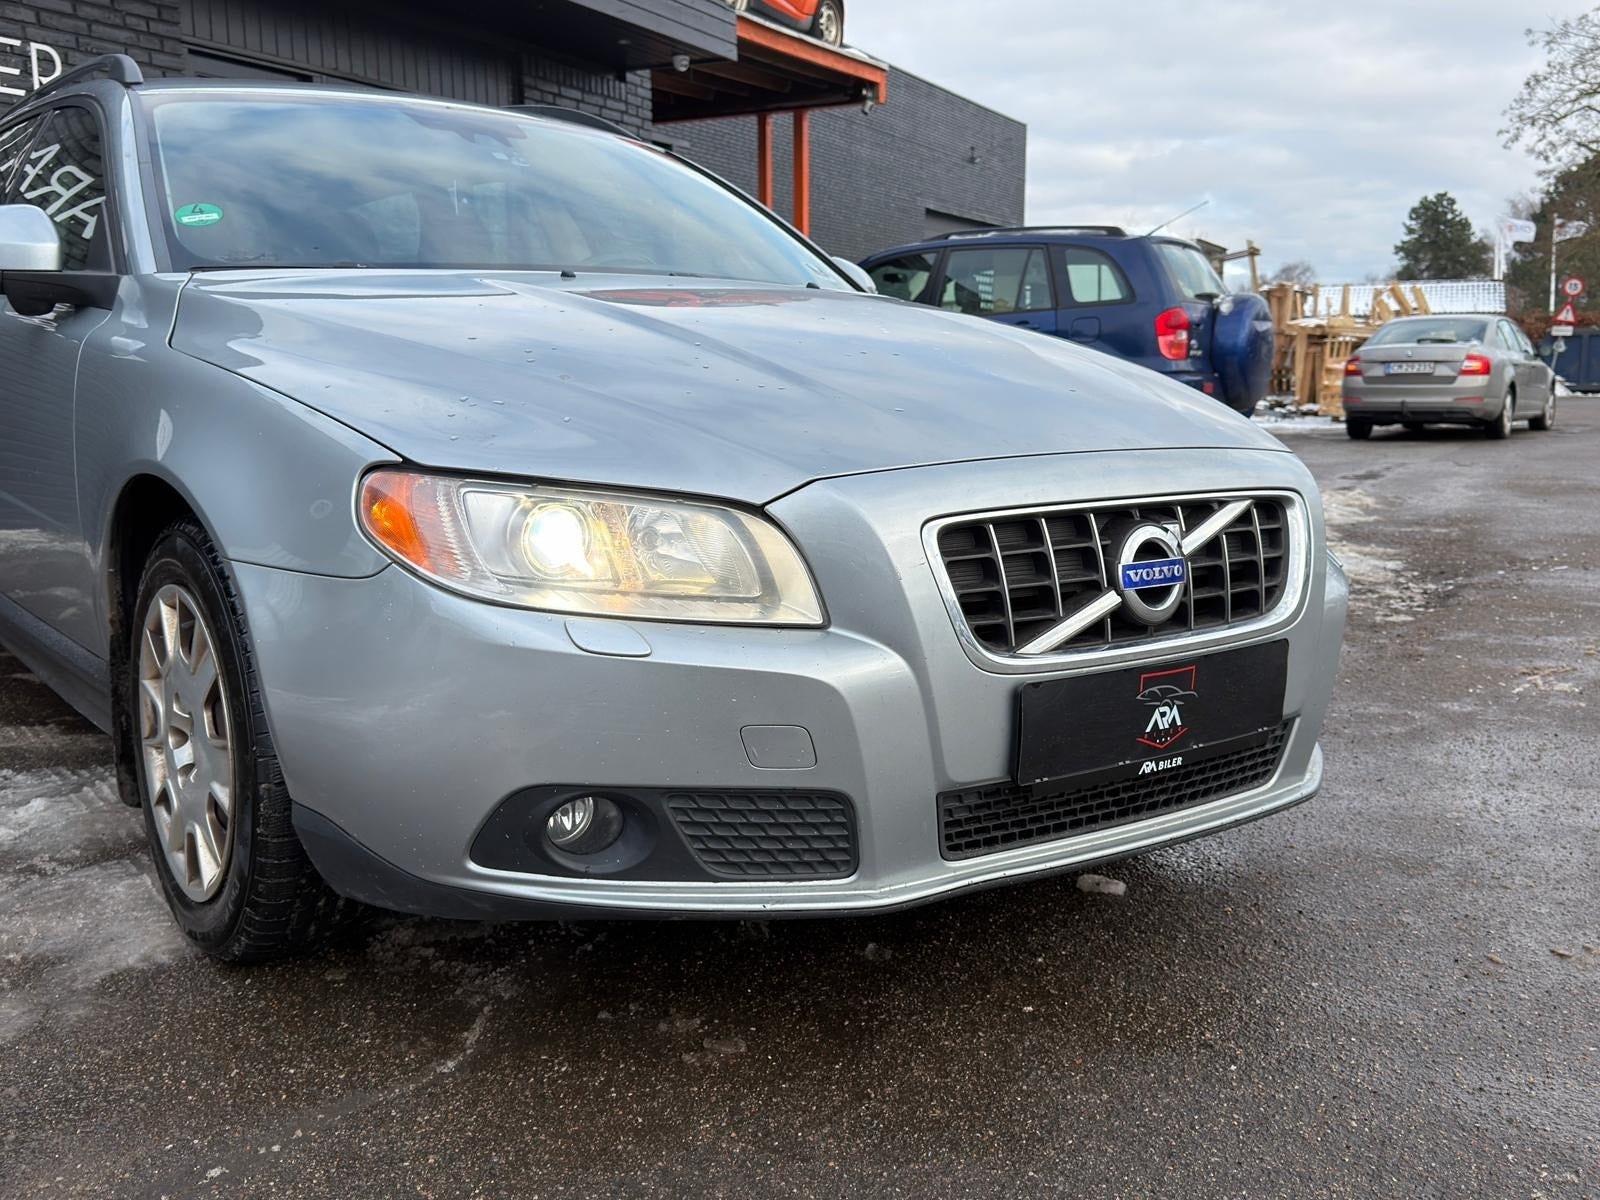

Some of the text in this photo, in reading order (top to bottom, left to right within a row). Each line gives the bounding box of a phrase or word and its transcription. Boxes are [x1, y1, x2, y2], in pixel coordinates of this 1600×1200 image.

[1126, 565, 1183, 583] VOLVO
[1145, 704, 1182, 733] ARA
[1138, 756, 1183, 775] ARA BILER
